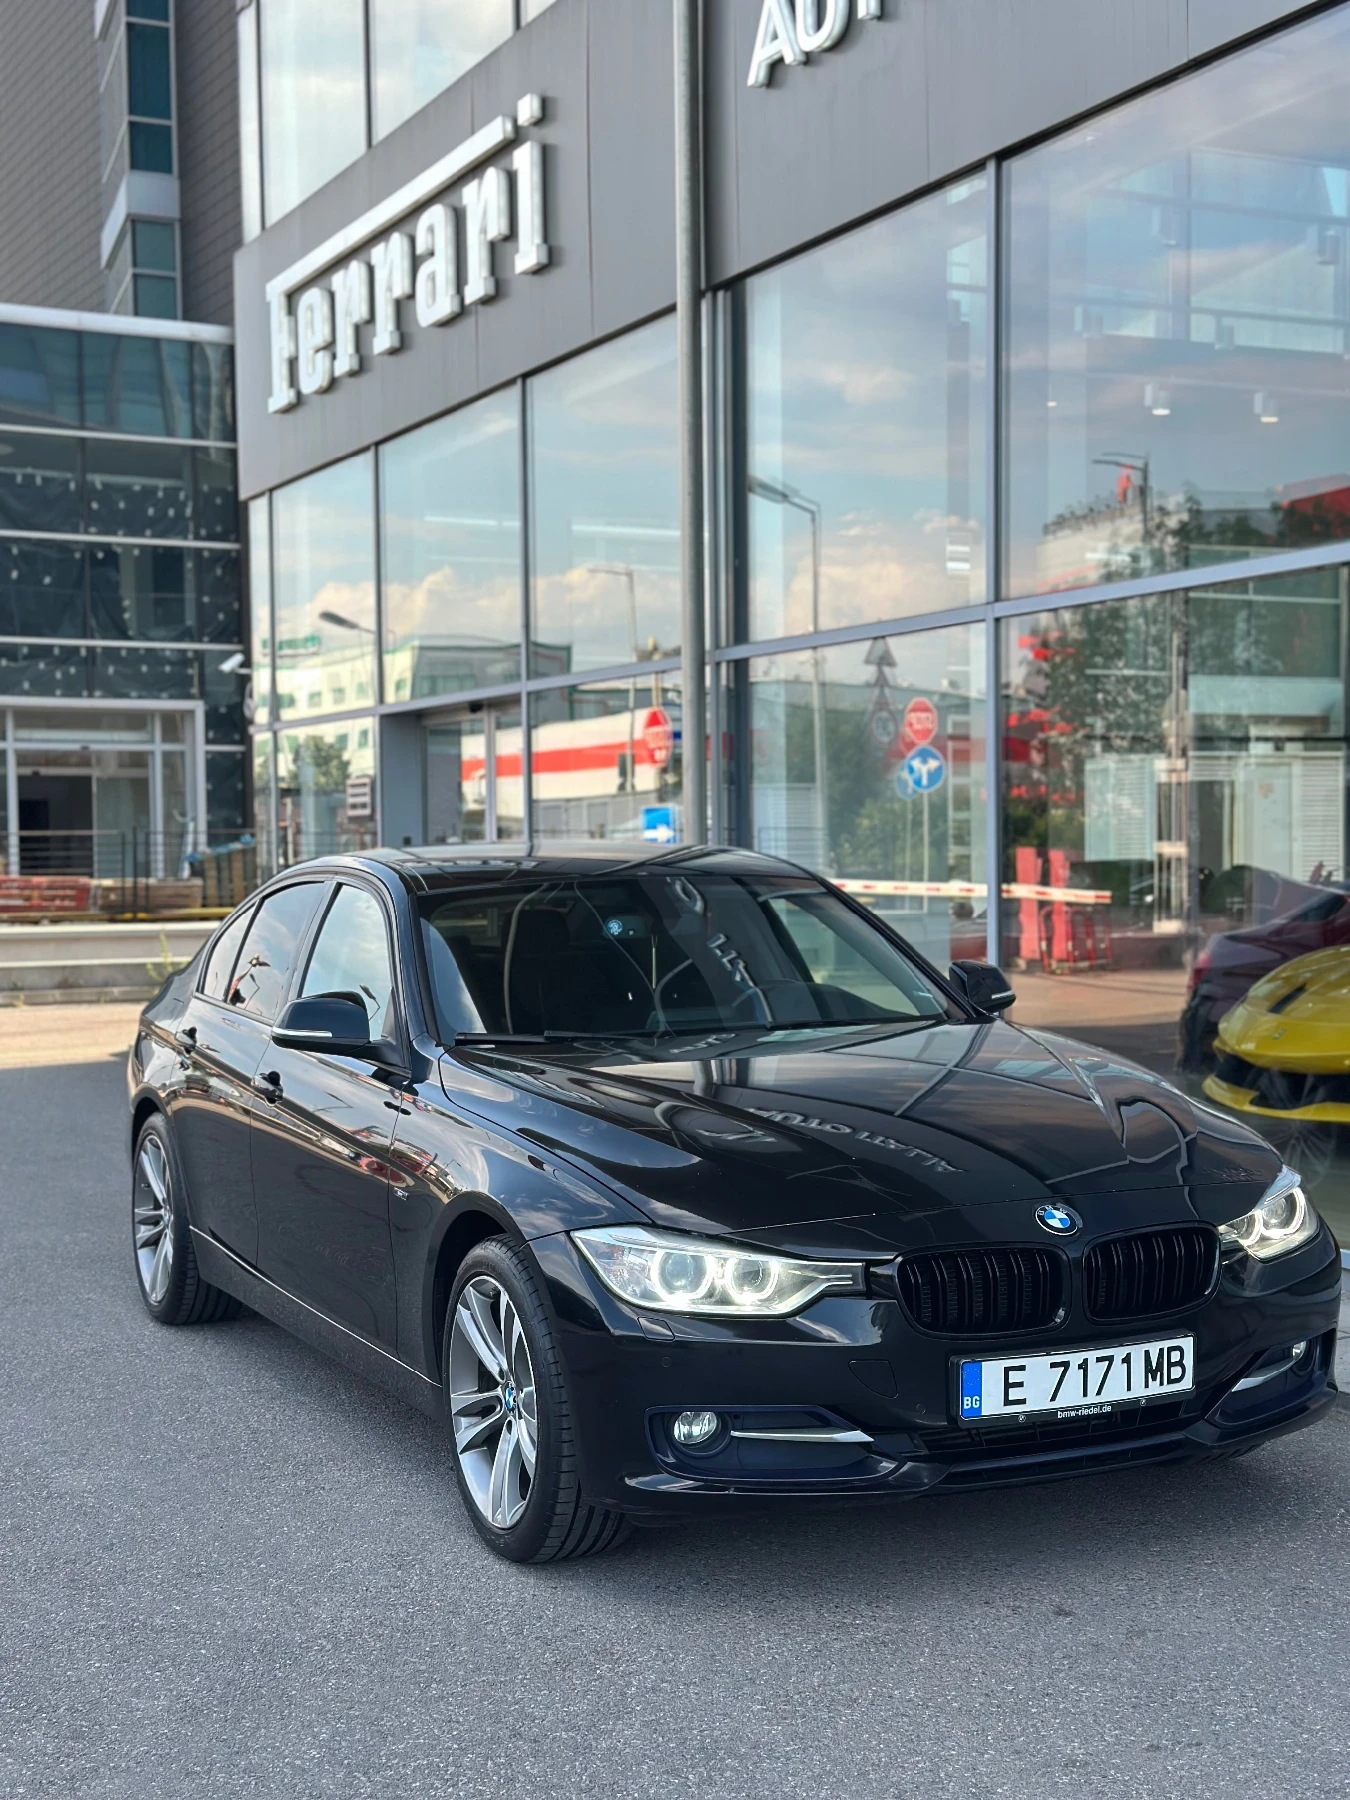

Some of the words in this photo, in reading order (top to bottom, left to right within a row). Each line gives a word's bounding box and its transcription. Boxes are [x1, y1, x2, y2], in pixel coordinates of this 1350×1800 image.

[265, 93, 549, 414] Ferrari
[1003, 1364, 1027, 1407] E
[963, 1395, 980, 1409] BG
[1057, 1404, 1112, 1419] bmw-riedel.de
